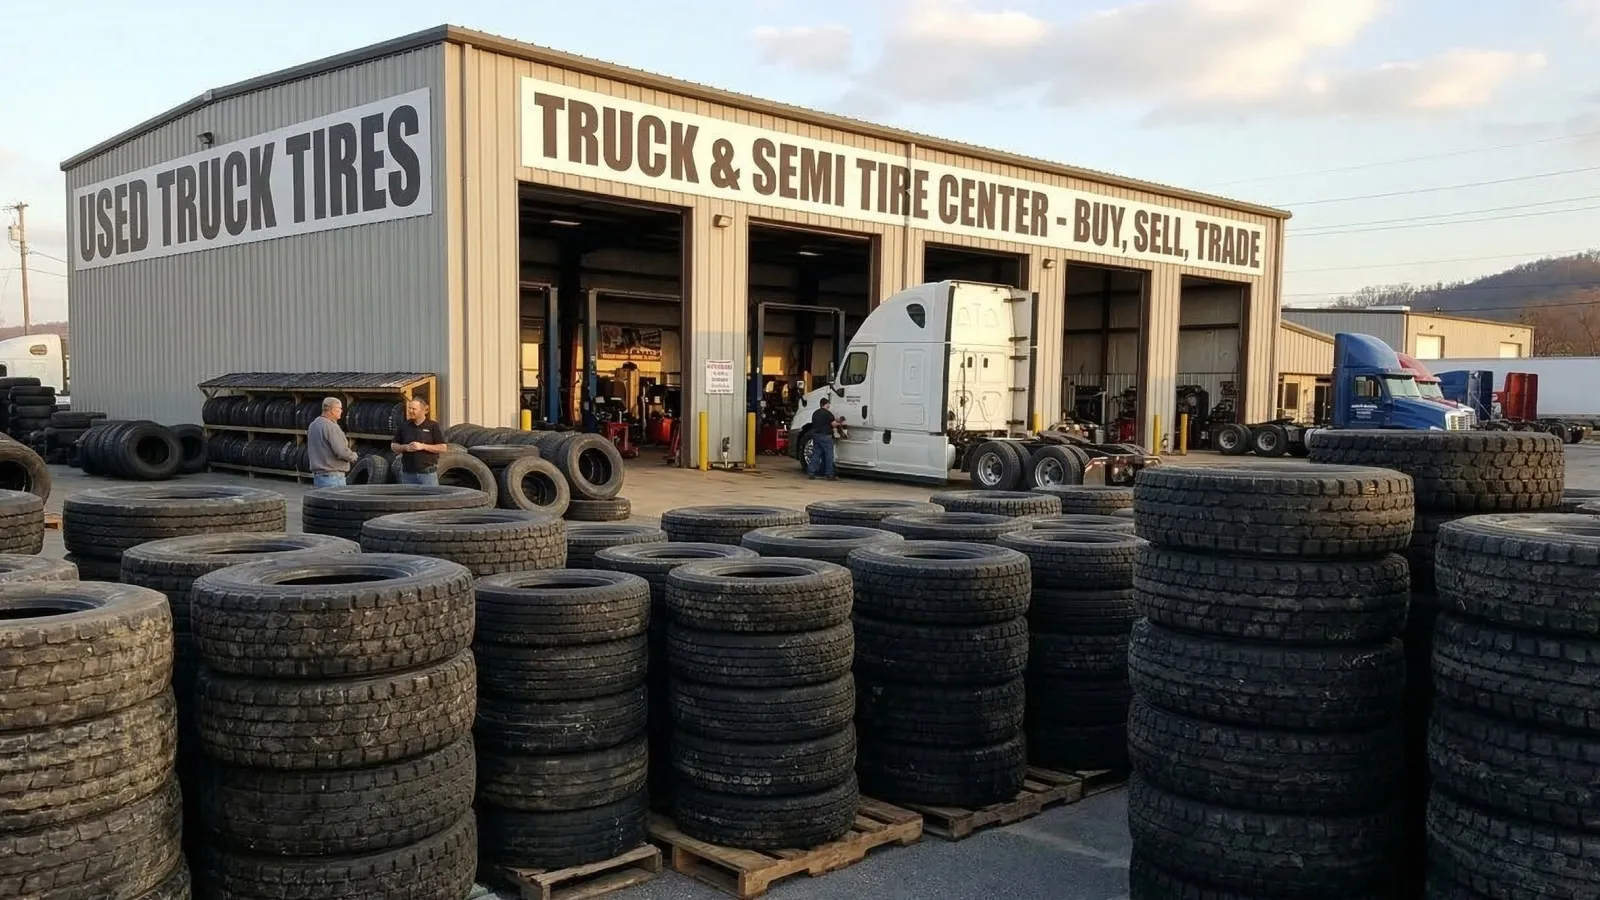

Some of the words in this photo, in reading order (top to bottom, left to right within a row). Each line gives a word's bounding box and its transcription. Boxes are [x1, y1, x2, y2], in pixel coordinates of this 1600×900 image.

[80, 180, 149, 261] USED
[157, 142, 277, 246] TRUCK
[286, 105, 421, 223] TIRES
[534, 92, 699, 183] TRUCK
[710, 138, 741, 190] &
[752, 138, 846, 206] SEMI
[856, 158, 929, 219] TIRE
[938, 174, 1049, 237] CENTER
[1056, 217, 1067, 226] -
[1073, 198, 1127, 253] BUY,
[1134, 210, 1189, 261] SELL,
[1195, 221, 1261, 268] TRADE
